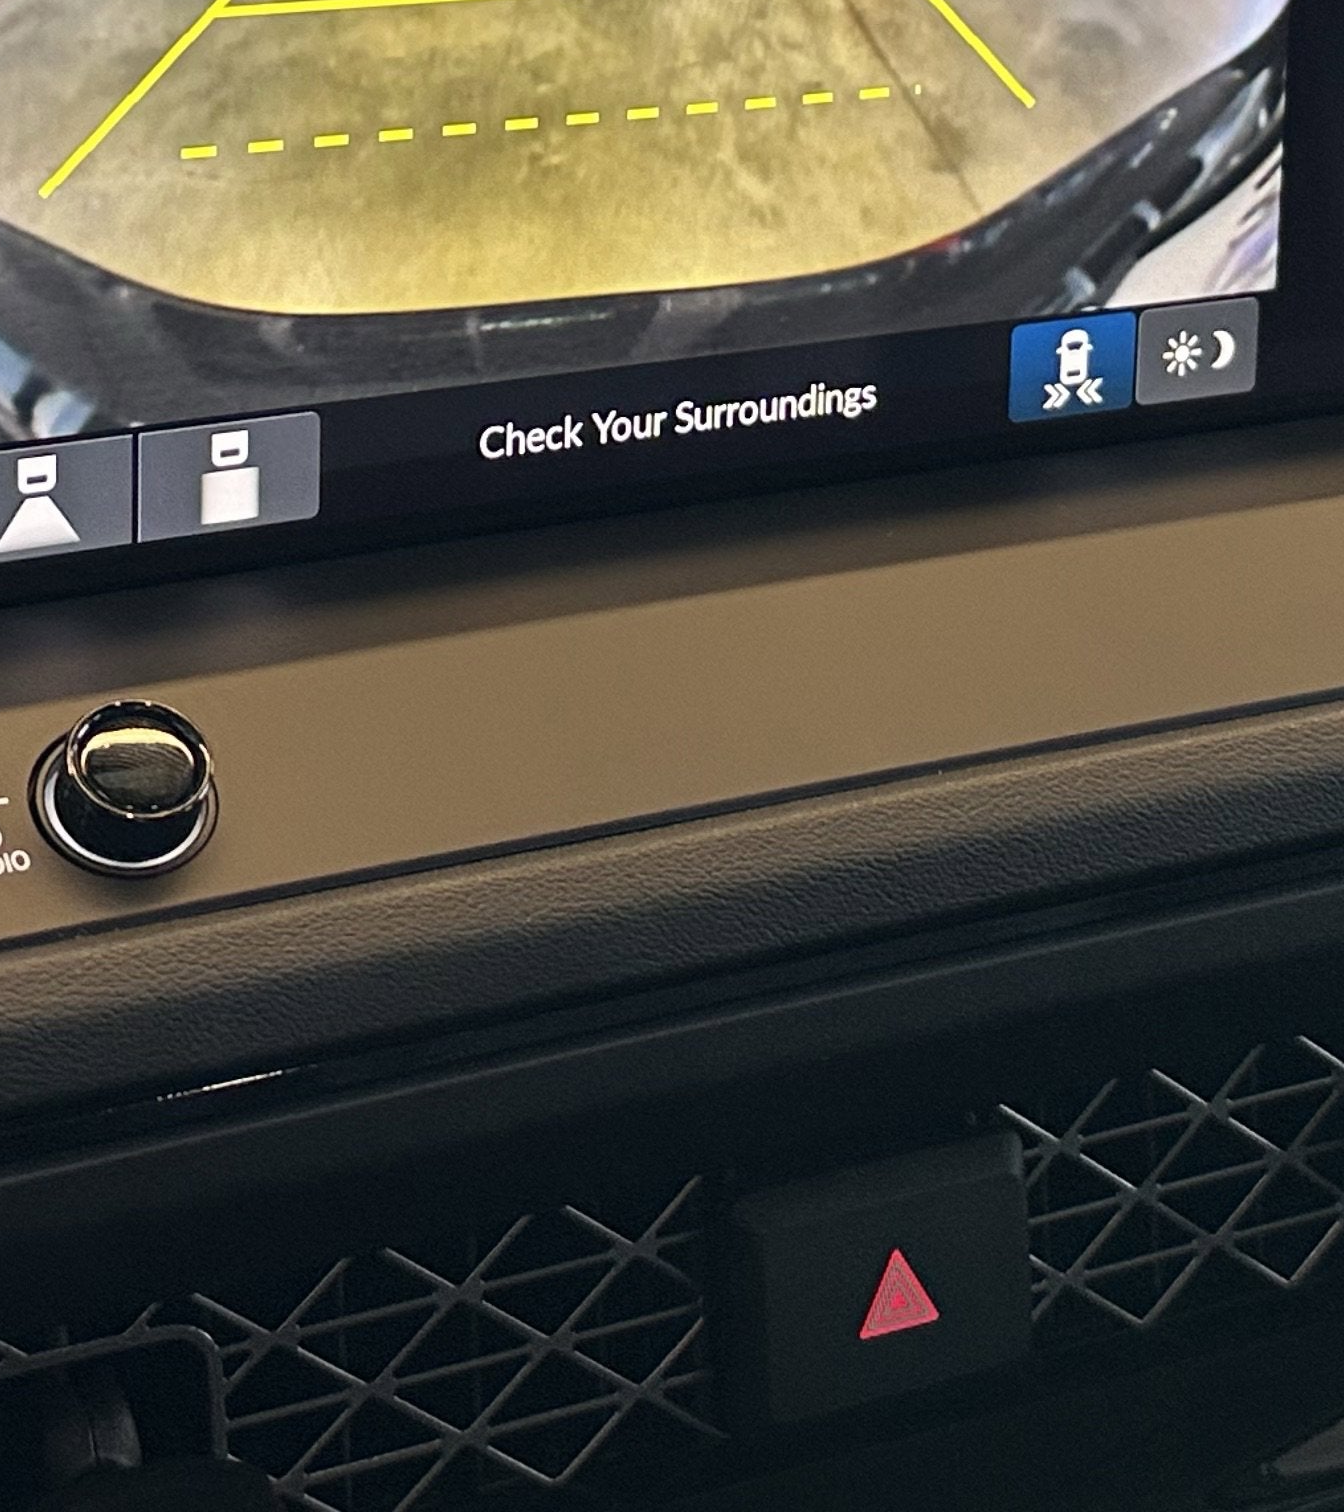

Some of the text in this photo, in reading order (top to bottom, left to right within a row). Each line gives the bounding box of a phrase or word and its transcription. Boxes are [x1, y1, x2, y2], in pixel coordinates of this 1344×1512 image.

[479, 382, 877, 459] Check Your Surroundings
